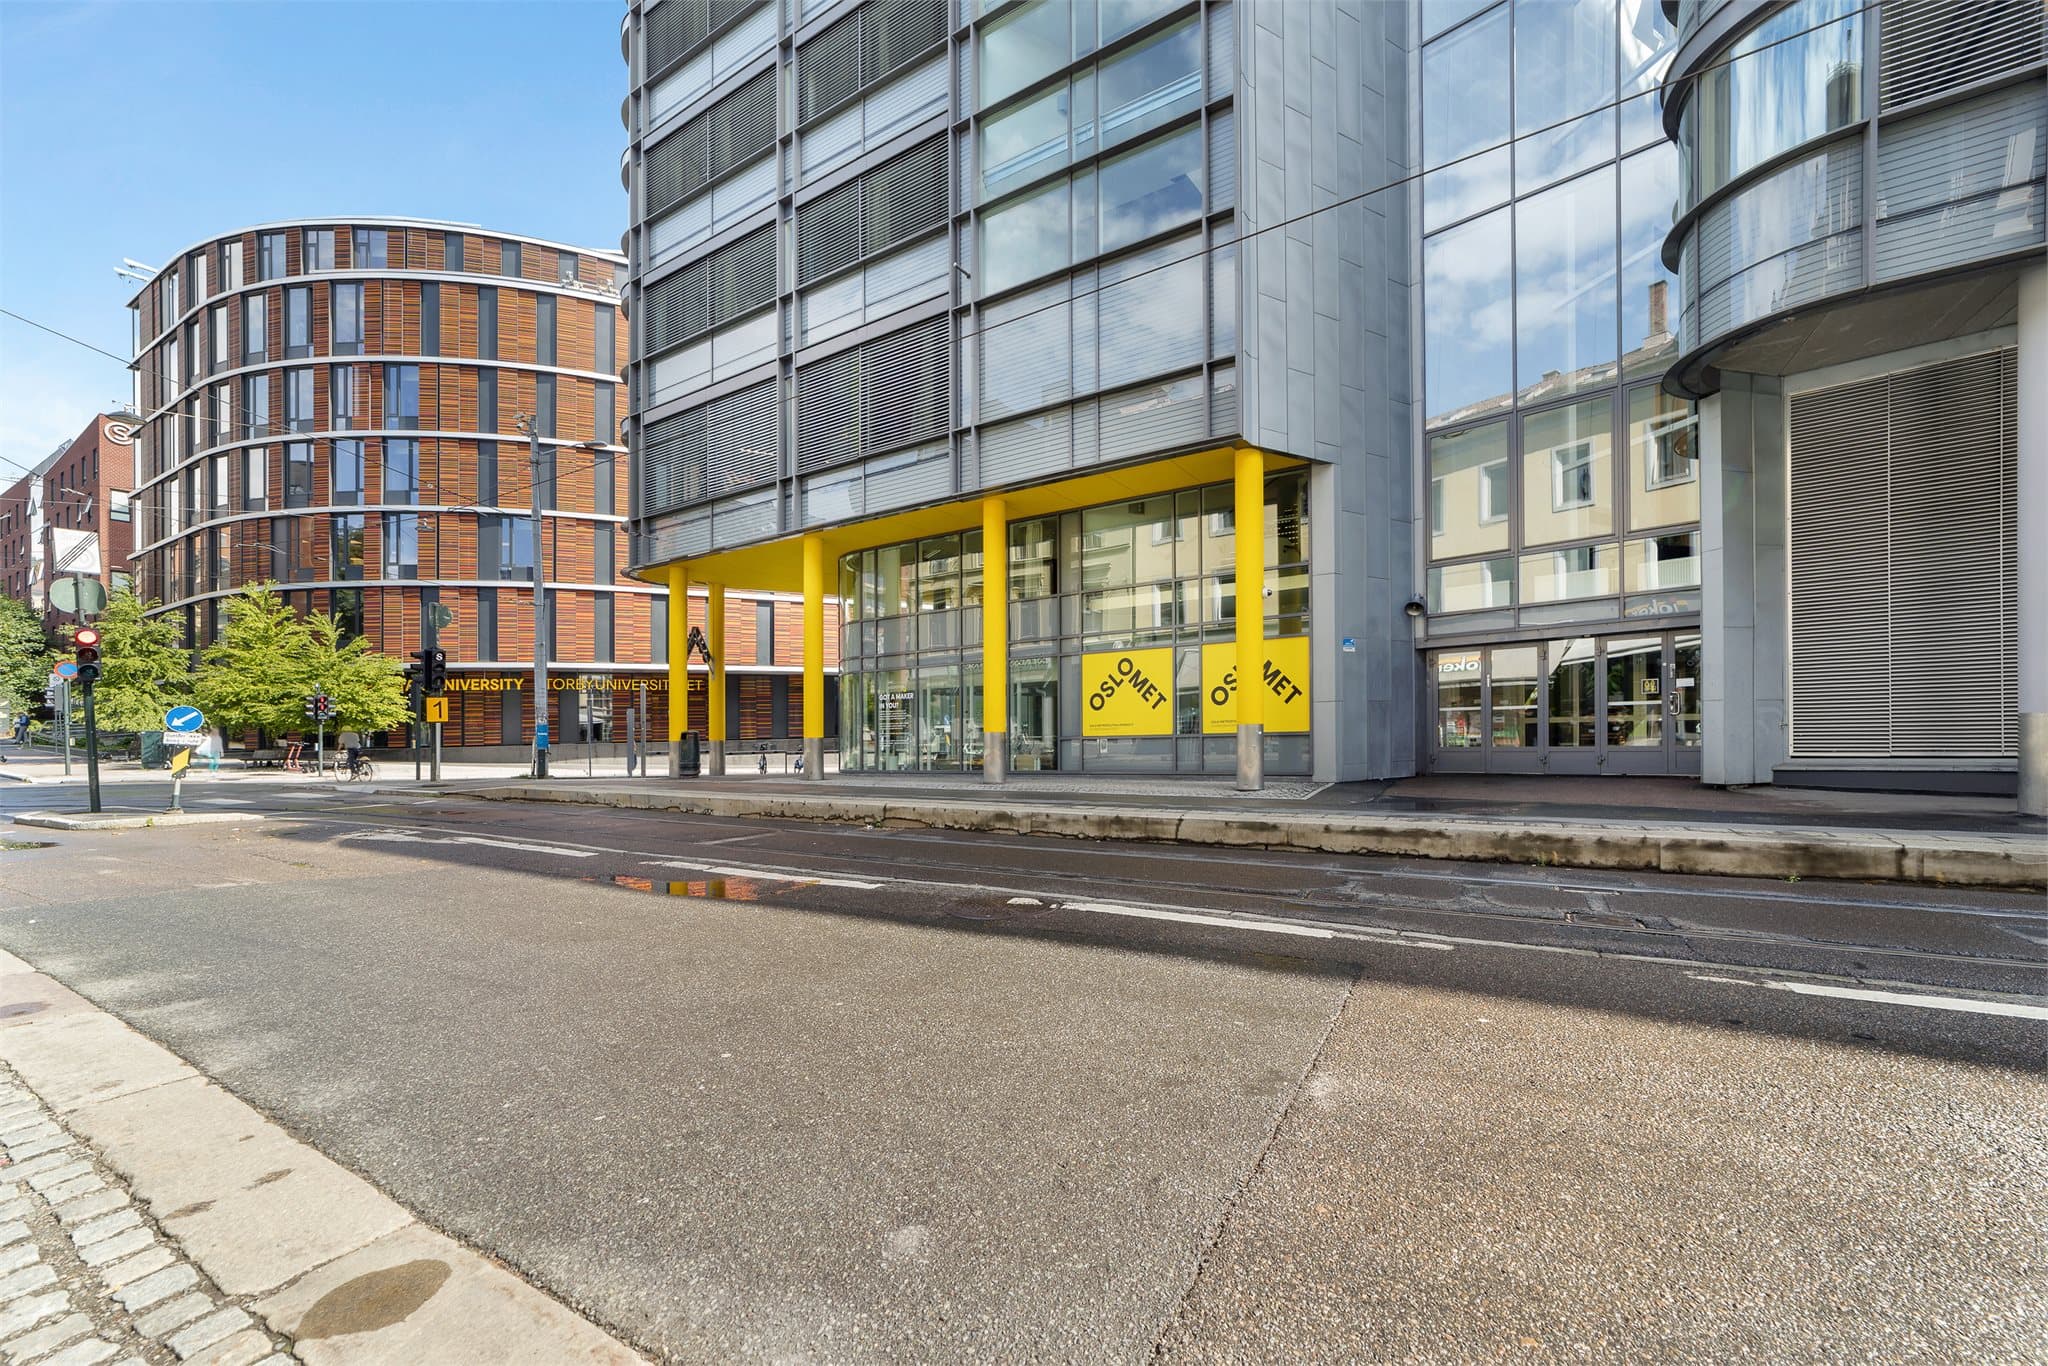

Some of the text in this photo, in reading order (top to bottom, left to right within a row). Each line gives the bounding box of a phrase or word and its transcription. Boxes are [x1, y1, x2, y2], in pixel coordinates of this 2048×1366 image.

[444, 678, 703, 691] NIVERSITY TORBYUNIVERSITET
[1089, 657, 1167, 711] OSLOMET
[1210, 659, 1303, 706] OSMET
[433, 701, 442, 719] 1
